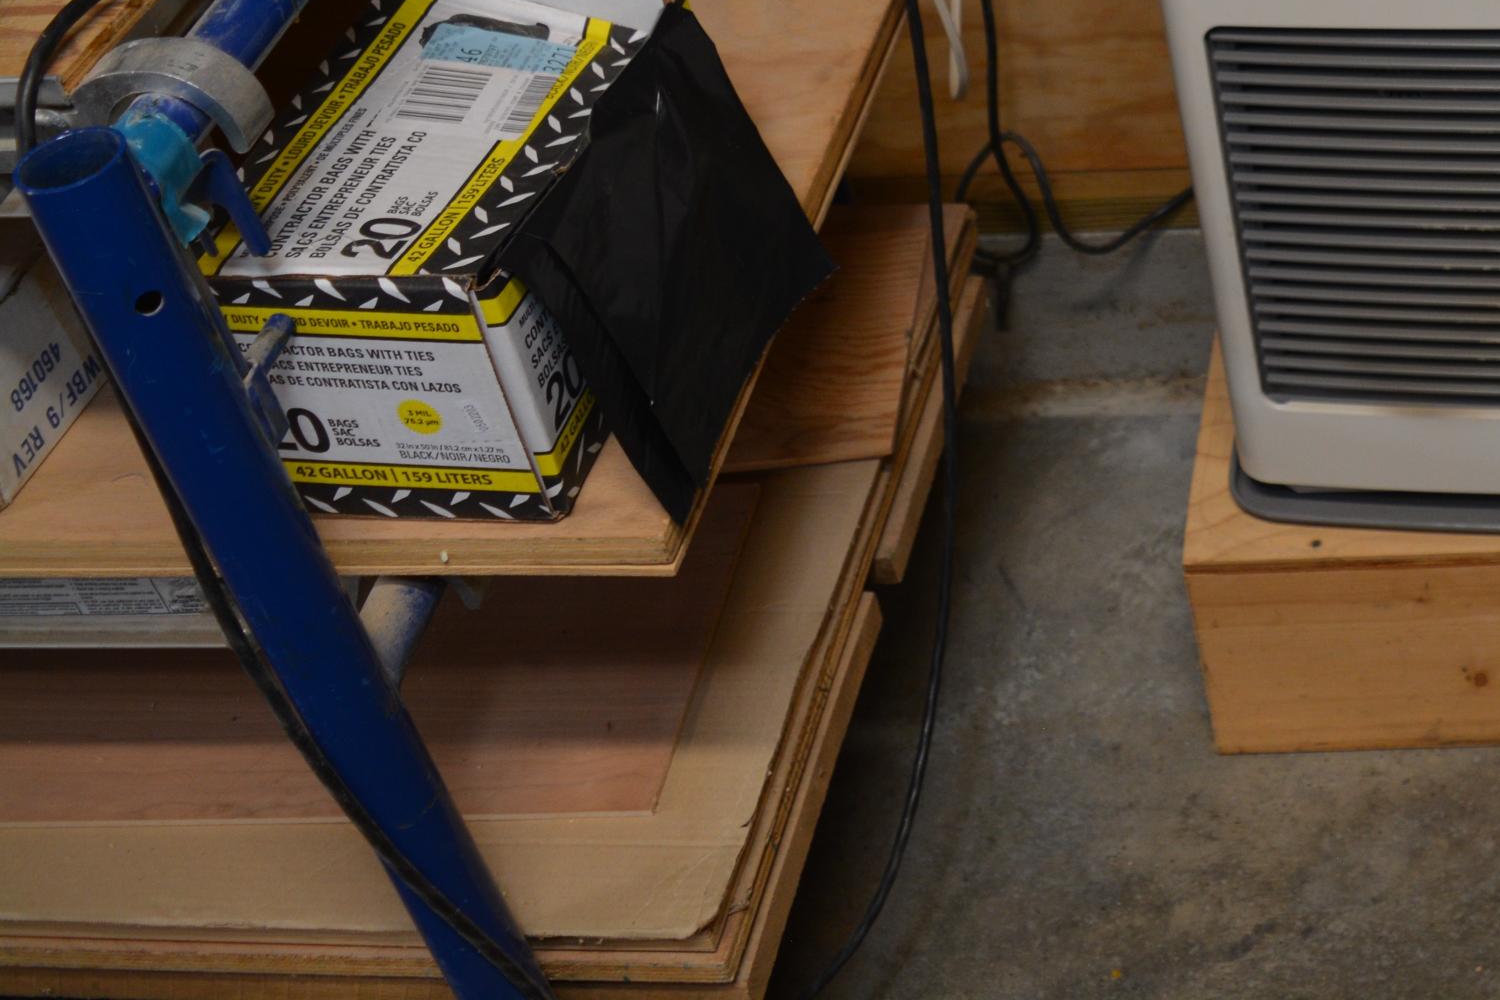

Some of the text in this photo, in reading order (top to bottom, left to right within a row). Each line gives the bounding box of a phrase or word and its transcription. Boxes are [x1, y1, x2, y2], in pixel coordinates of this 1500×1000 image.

[264, 167, 287, 193] DUTY
[288, 131, 316, 160] LOURD
[309, 99, 342, 130] DEVOIR
[344, 56, 380, 95] TRABAJO
[371, 22, 406, 56] PESADO
[407, 131, 427, 145] CO
[355, 144, 414, 206] CONTRATISTA
[263, 186, 326, 258] CONTRACTOR
[321, 157, 353, 185] BAGS
[345, 129, 377, 159] WITH
[285, 231, 318, 258] SACS
[309, 153, 376, 231] ENTREPRENEUR
[371, 136, 397, 161] TIES
[387, 195, 409, 214] BAGS
[411, 191, 439, 217] BOLSAS
[348, 205, 365, 220] DE
[399, 202, 417, 215] SAC
[407, 157, 505, 263] 42 GALLON 159 LITERS
[309, 221, 352, 259] BOLSAS
[340, 217, 422, 260] 20
[231, 314, 259, 325] DUTY
[310, 317, 350, 329] DEVOIR
[360, 320, 412, 331] TRABAJO
[414, 322, 460, 333] PESADO
[238, 343, 436, 362] COACTOR BAGS WITH TIES
[531, 330, 554, 369] SACS
[11, 342, 61, 413] 460168
[271, 360, 423, 377] ACS ENTREPRENEUR TIES
[287, 375, 305, 386] DE
[306, 376, 390, 390] CONTRATISTA
[391, 380, 419, 392] CON
[421, 382, 462, 394] LAZOS
[546, 351, 583, 431] 20
[277, 407, 331, 454] 0
[328, 418, 359, 428] BAGS
[332, 428, 355, 437] SAC
[12, 425, 45, 478] REV
[336, 437, 381, 448] BOLSAS
[295, 466, 493, 485] 42 GALLON 159 LITERS
